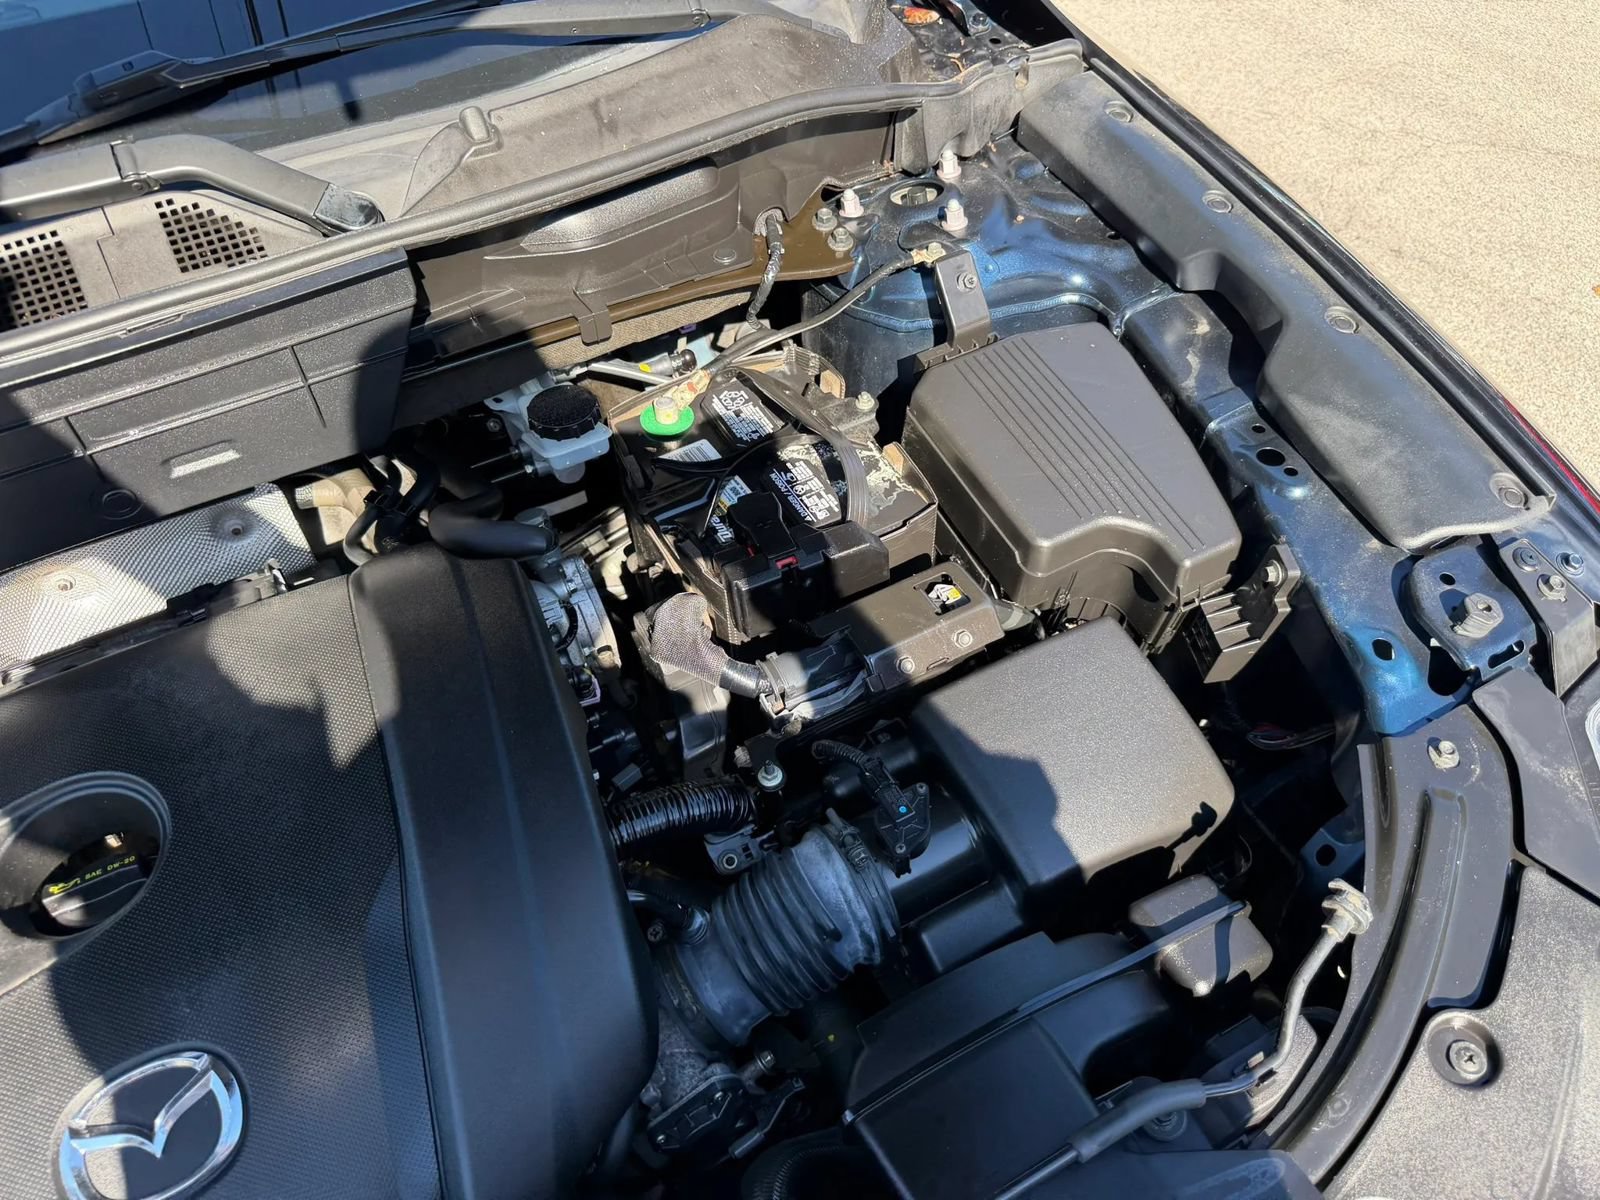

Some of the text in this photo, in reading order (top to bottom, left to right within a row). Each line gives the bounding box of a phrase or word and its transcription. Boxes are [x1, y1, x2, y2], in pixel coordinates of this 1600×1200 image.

[769, 472, 788, 492] POISON
[787, 494, 808, 517] DANGER
[85, 855, 135, 880] SAE 0W-20
